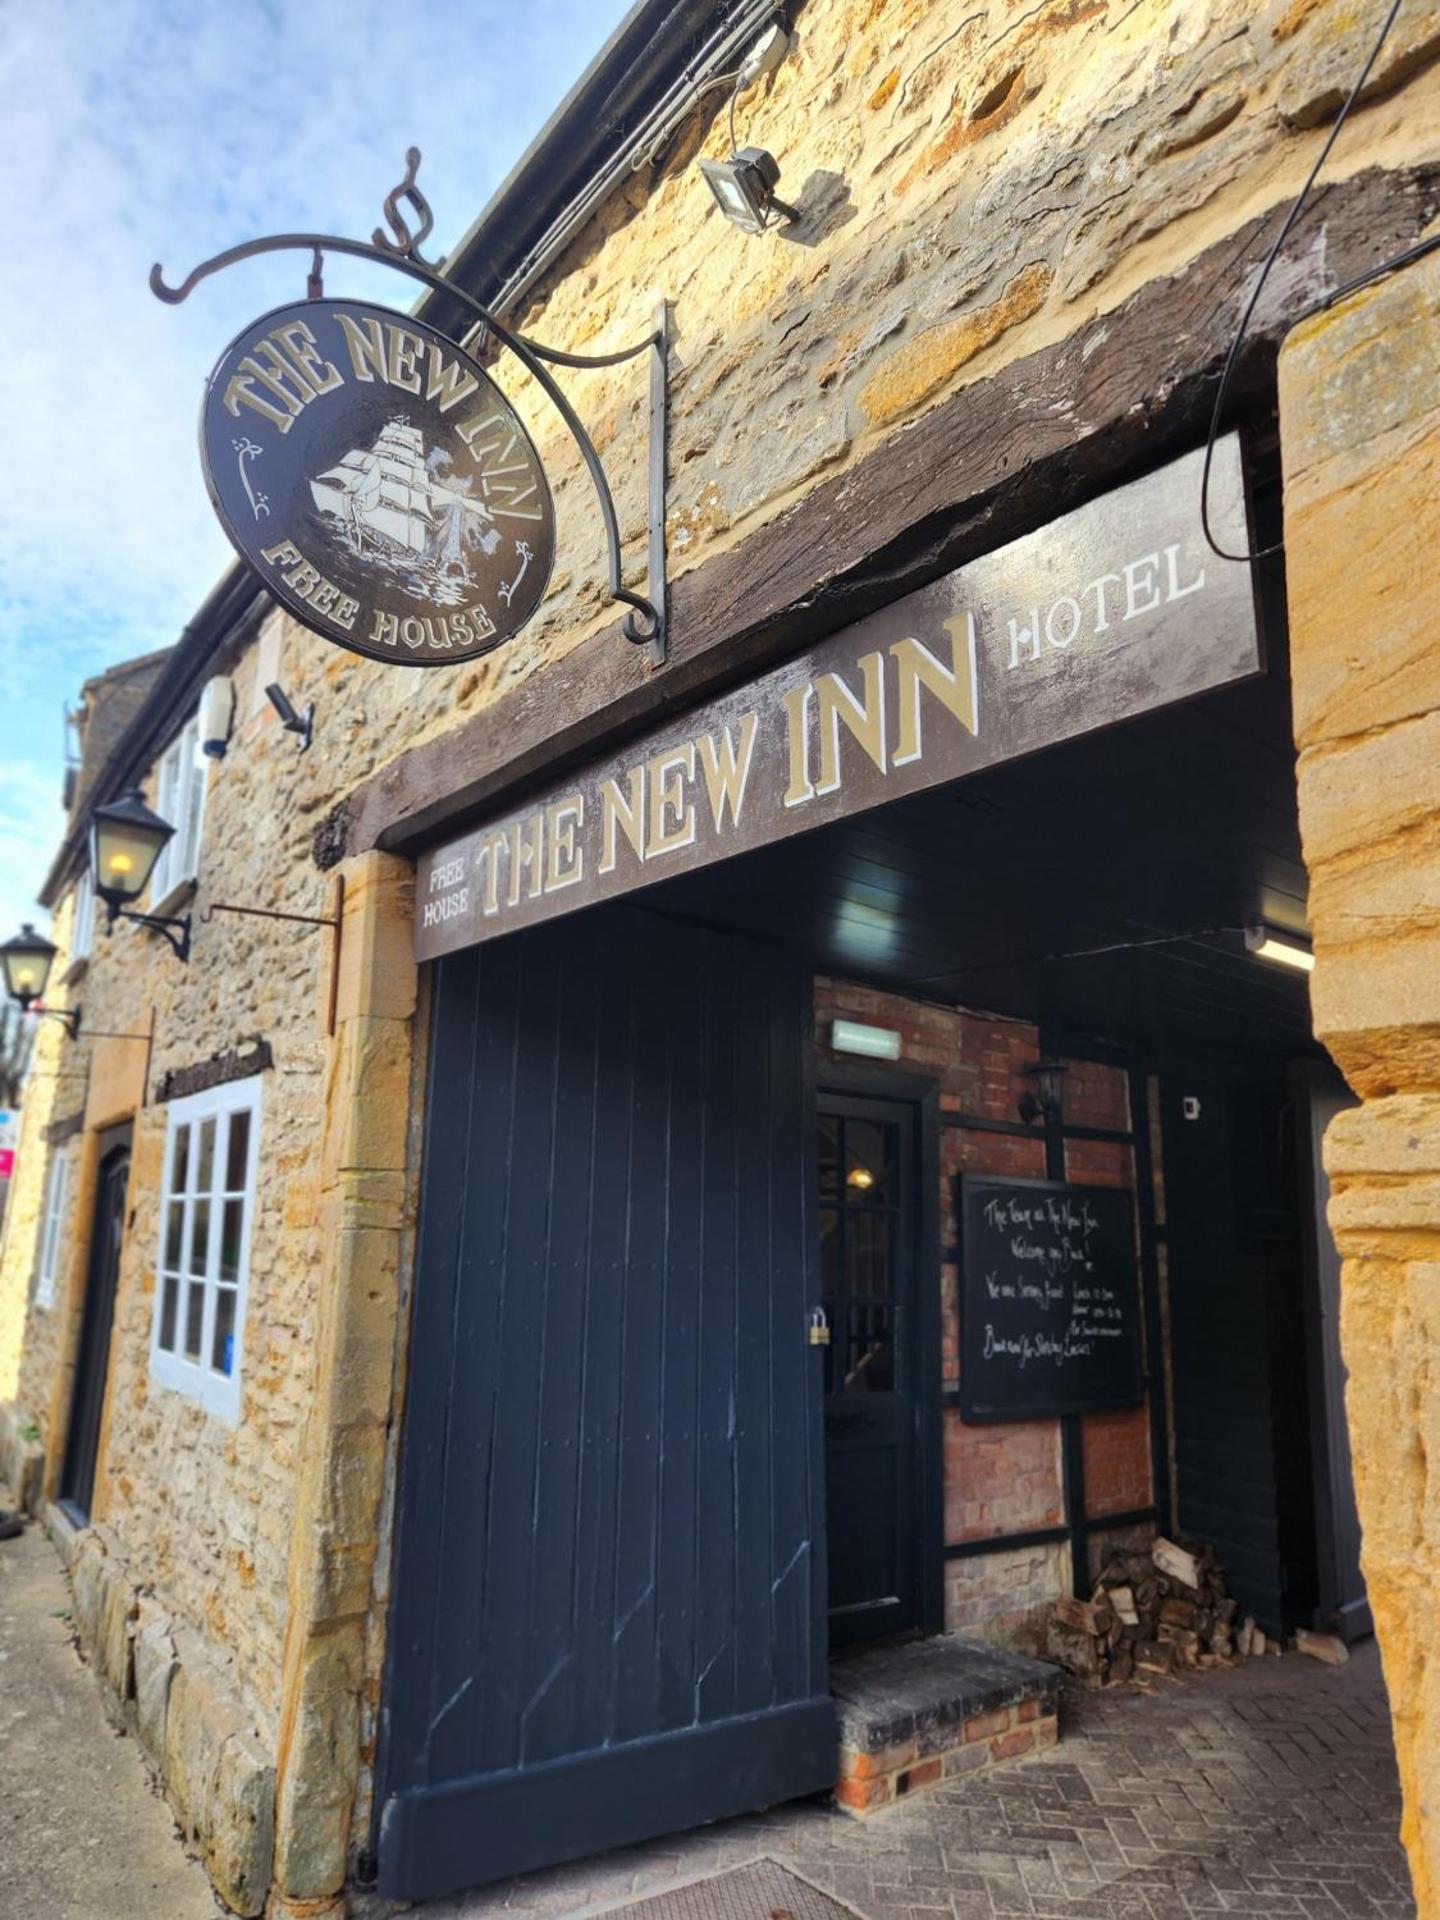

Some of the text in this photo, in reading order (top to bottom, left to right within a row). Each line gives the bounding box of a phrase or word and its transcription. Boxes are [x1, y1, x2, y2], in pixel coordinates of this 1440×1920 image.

[223, 313, 543, 521] THE NEW INN
[260, 539, 497, 650] FREE HOUSE
[475, 543, 1206, 916] THE NEW INN HOTEL
[423, 887, 469, 928] HOUSE
[429, 857, 465, 893] FREE
